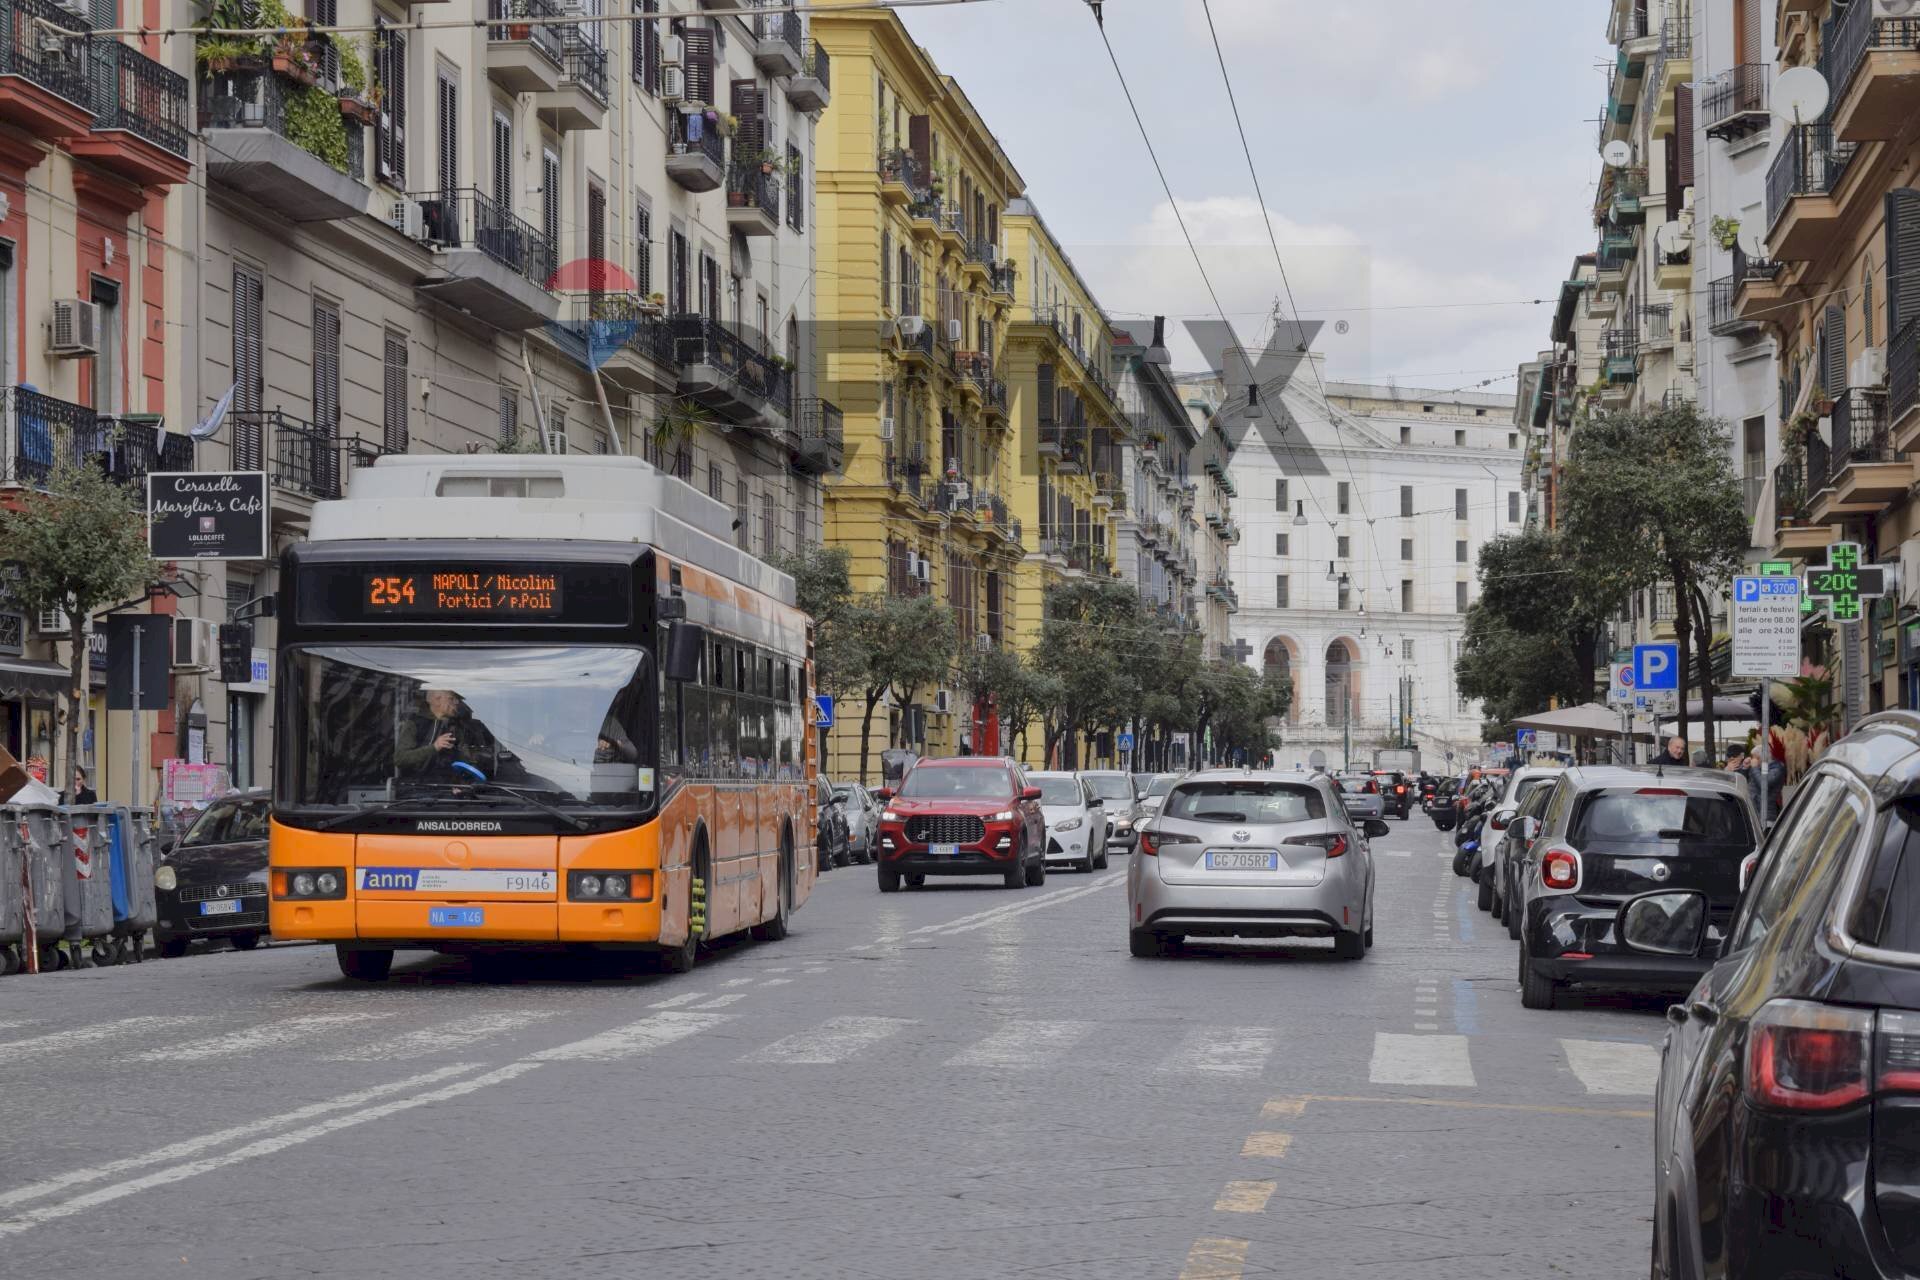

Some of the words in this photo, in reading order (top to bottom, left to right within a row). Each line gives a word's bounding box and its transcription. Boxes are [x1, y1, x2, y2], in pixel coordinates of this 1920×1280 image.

[174, 476, 242, 492] Cerasella
[152, 497, 225, 518] Marylin's
[433, 574, 480, 590] NAPOLI
[496, 574, 556, 590] Nicolini
[370, 577, 416, 605] 254
[1741, 580, 1757, 601] P
[438, 592, 492, 609] Portici
[1739, 605, 1761, 613] feriali
[1770, 605, 1794, 613] festivi
[1643, 650, 1669, 685] P
[417, 821, 502, 831] ANSALDOBREDA
[1214, 854, 1229, 866] GG
[1232, 854, 1269, 867] 705RP
[368, 873, 413, 888] anm
[506, 877, 550, 890] F9146
[432, 911, 445, 923] NA
[461, 911, 481, 923] 146
